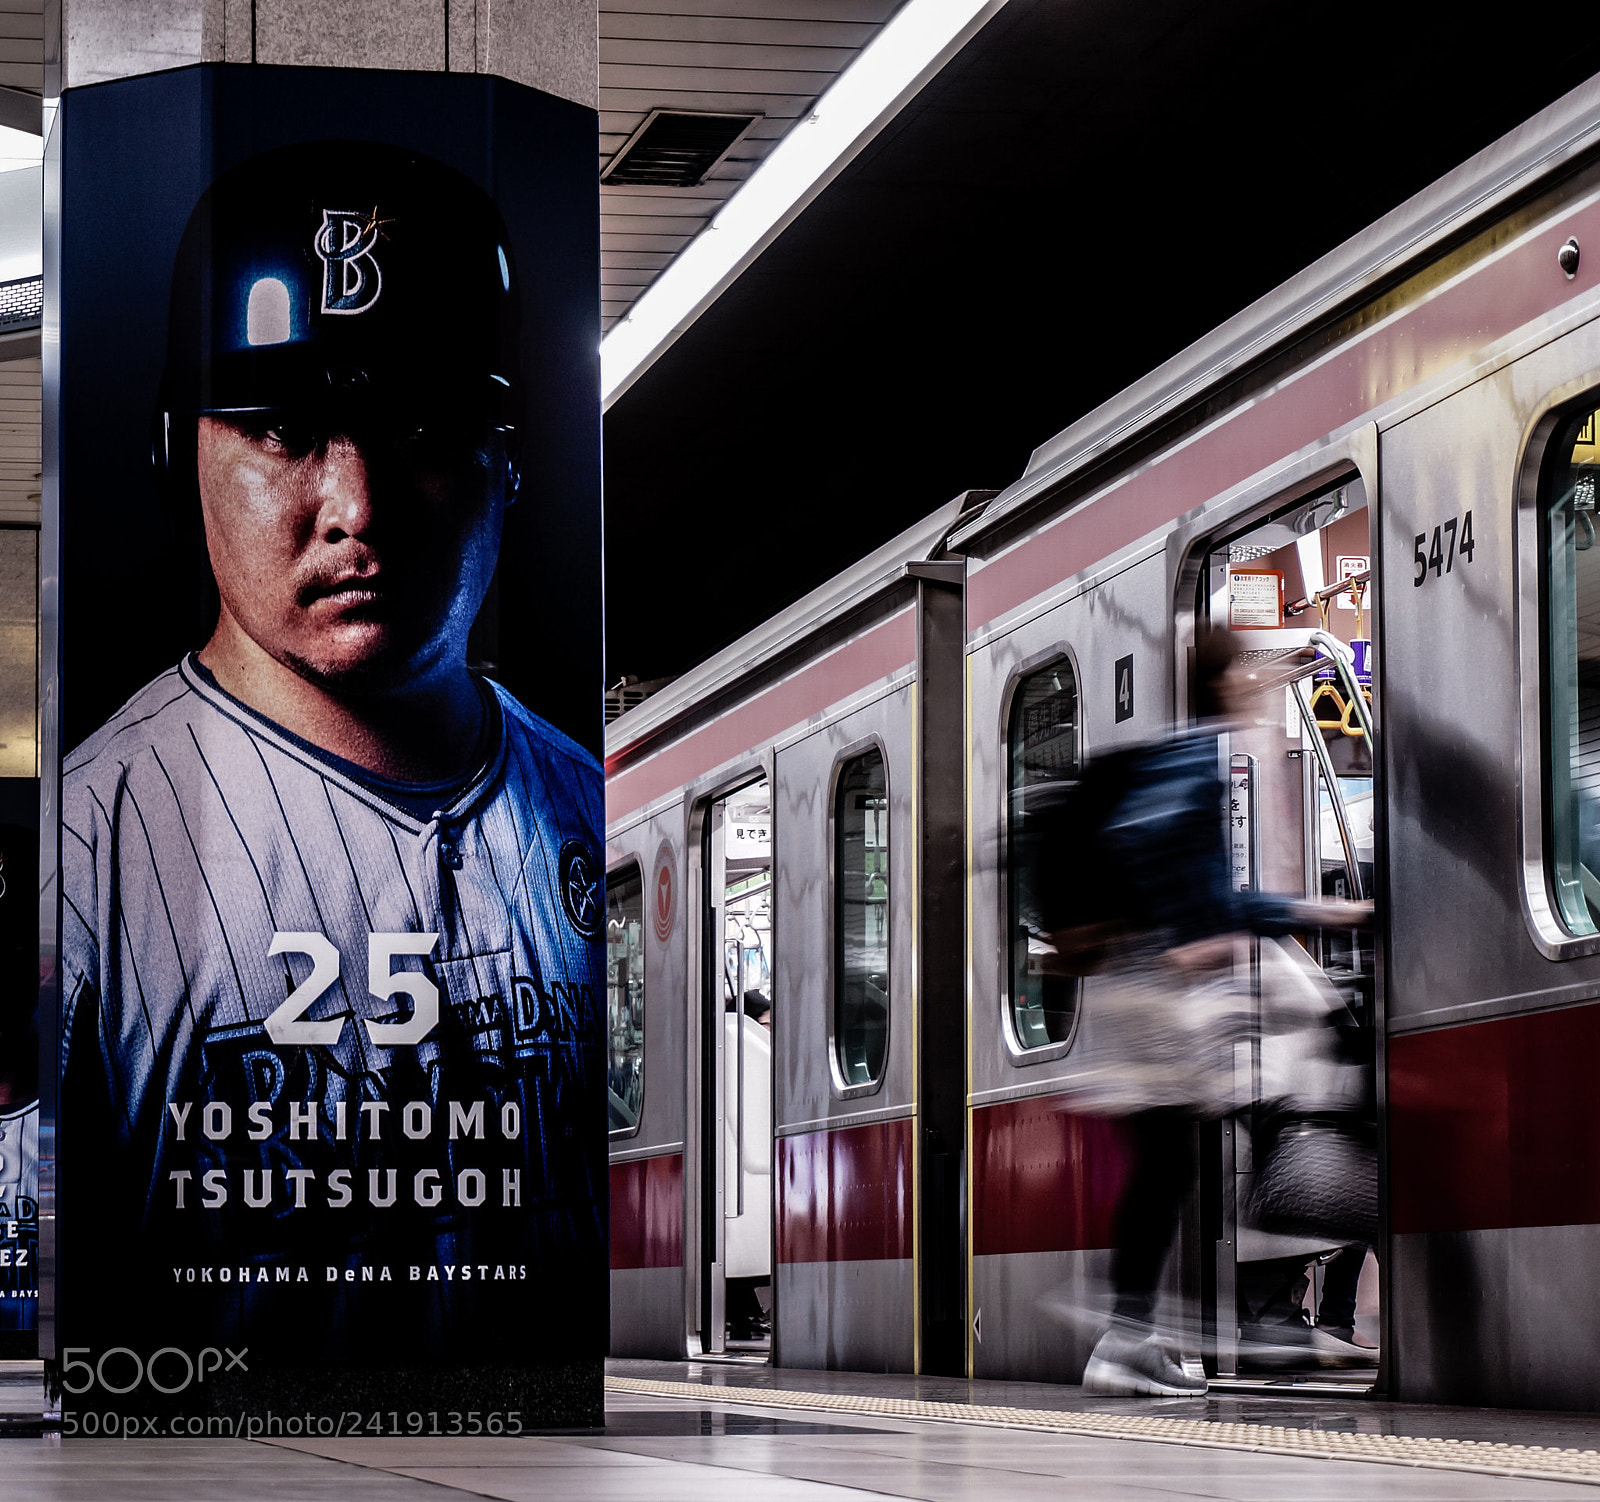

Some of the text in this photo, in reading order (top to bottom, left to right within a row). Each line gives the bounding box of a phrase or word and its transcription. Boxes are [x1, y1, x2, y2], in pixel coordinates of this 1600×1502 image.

[1413, 510, 1475, 587] 5474
[1119, 667, 1130, 711] 4
[263, 932, 441, 1046] 25
[169, 1101, 521, 1141] YOSHITOMO
[169, 1169, 522, 1209] TSUTSUGOH
[173, 1265, 527, 1283] YOKOHAMA DeNA BAYSTARS
